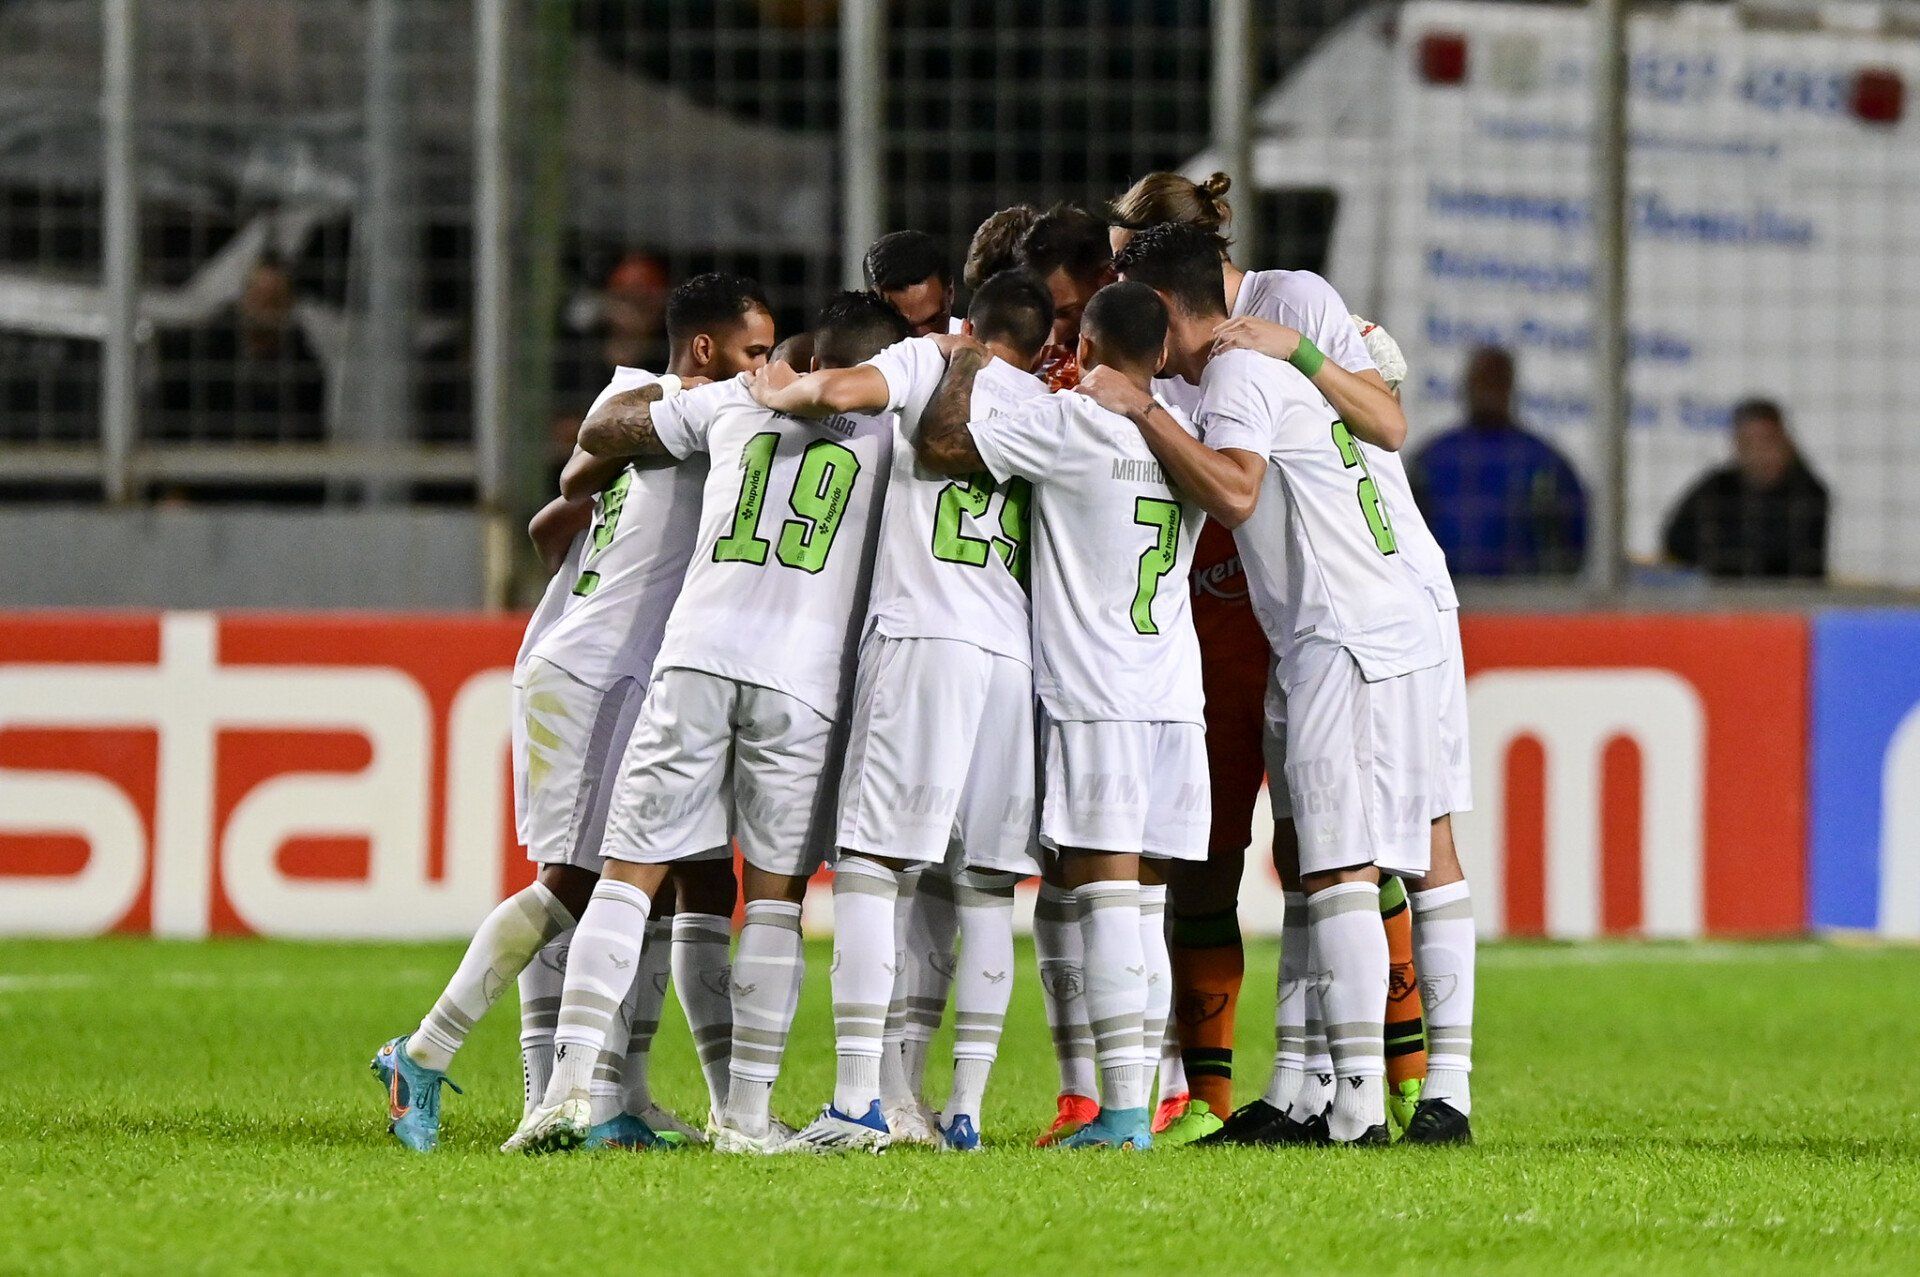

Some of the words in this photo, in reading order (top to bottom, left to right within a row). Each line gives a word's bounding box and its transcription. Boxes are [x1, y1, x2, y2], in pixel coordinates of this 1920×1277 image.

[747, 470, 761, 508] hapvida
[1111, 457, 1165, 484] MATHEU
[711, 431, 861, 575] 19
[826, 486, 842, 523] hapvida
[1166, 509, 1176, 549] hapvida
[1130, 496, 1183, 635] 7
